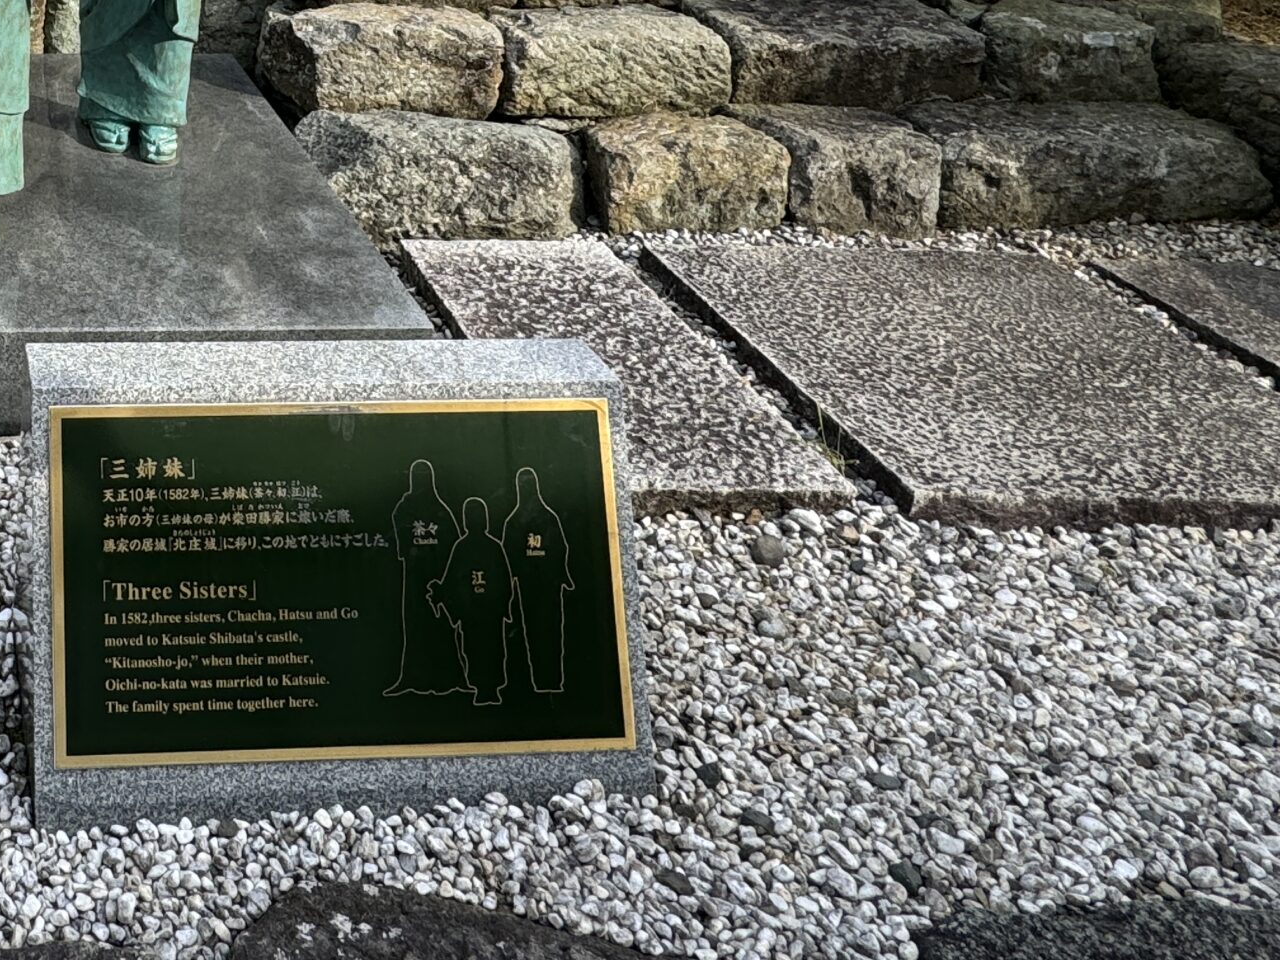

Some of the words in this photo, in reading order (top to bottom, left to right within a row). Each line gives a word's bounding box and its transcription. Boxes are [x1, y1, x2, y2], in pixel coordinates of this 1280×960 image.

[471, 570, 487, 586] 江
[104, 612, 118, 625] In
[184, 611, 226, 624] sisters,
[227, 609, 277, 622] Chacha,
[278, 608, 313, 620] Hatsu
[315, 607, 338, 619] and
[340, 606, 359, 619] Go
[104, 633, 144, 647] moved
[146, 634, 159, 646] to
[161, 632, 207, 646] Katsuie
[208, 630, 263, 644] Shibata's
[265, 630, 303, 643] castle,
[201, 654, 233, 666] when
[235, 653, 264, 666] their
[267, 651, 314, 665] mother,
[105, 677, 188, 691] Oichi-no-kata
[190, 678, 213, 689] was
[216, 675, 263, 688] married
[266, 675, 279, 687] to
[281, 673, 330, 686] Katsuie.
[105, 700, 129, 713] The
[132, 699, 170, 715] family
[172, 700, 204, 715] spent
[207, 698, 234, 711] time
[236, 696, 286, 713] together
[288, 696, 319, 708] here.
